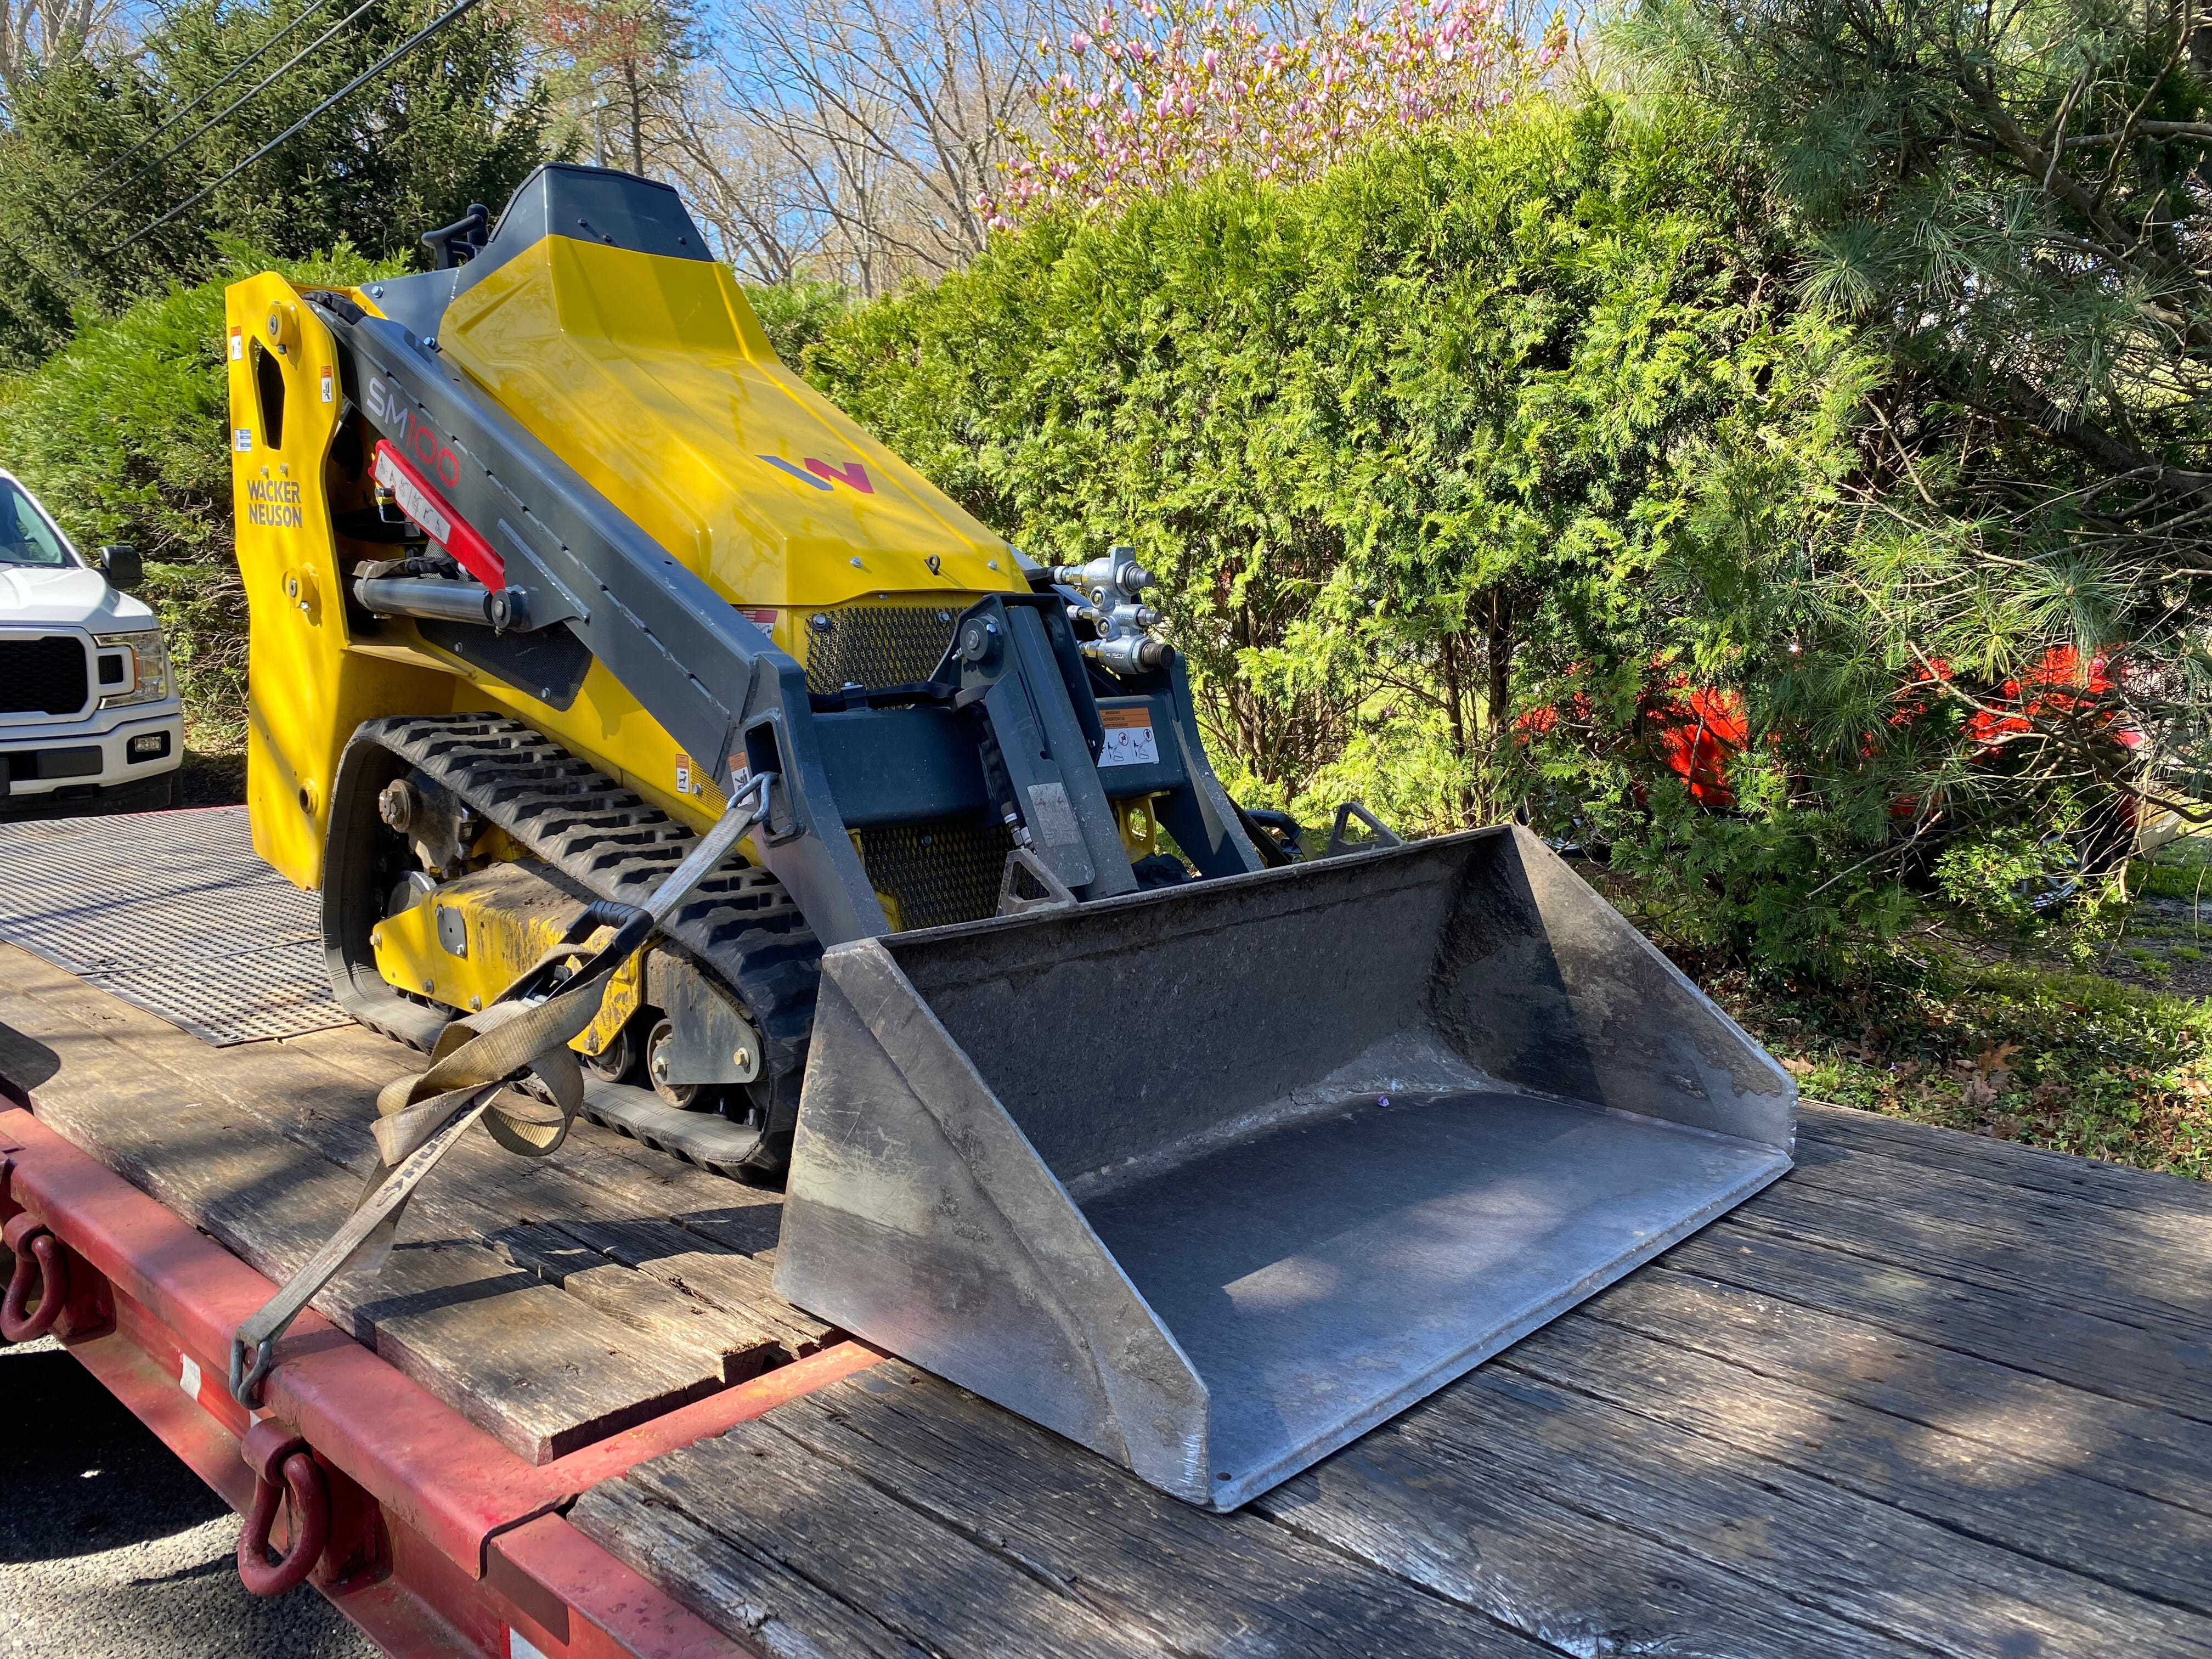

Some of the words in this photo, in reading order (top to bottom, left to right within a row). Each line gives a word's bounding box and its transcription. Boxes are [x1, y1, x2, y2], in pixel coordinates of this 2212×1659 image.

[366, 377, 460, 488] SM100
[246, 479, 301, 503] WACKER
[249, 503, 303, 528] NEUSON
